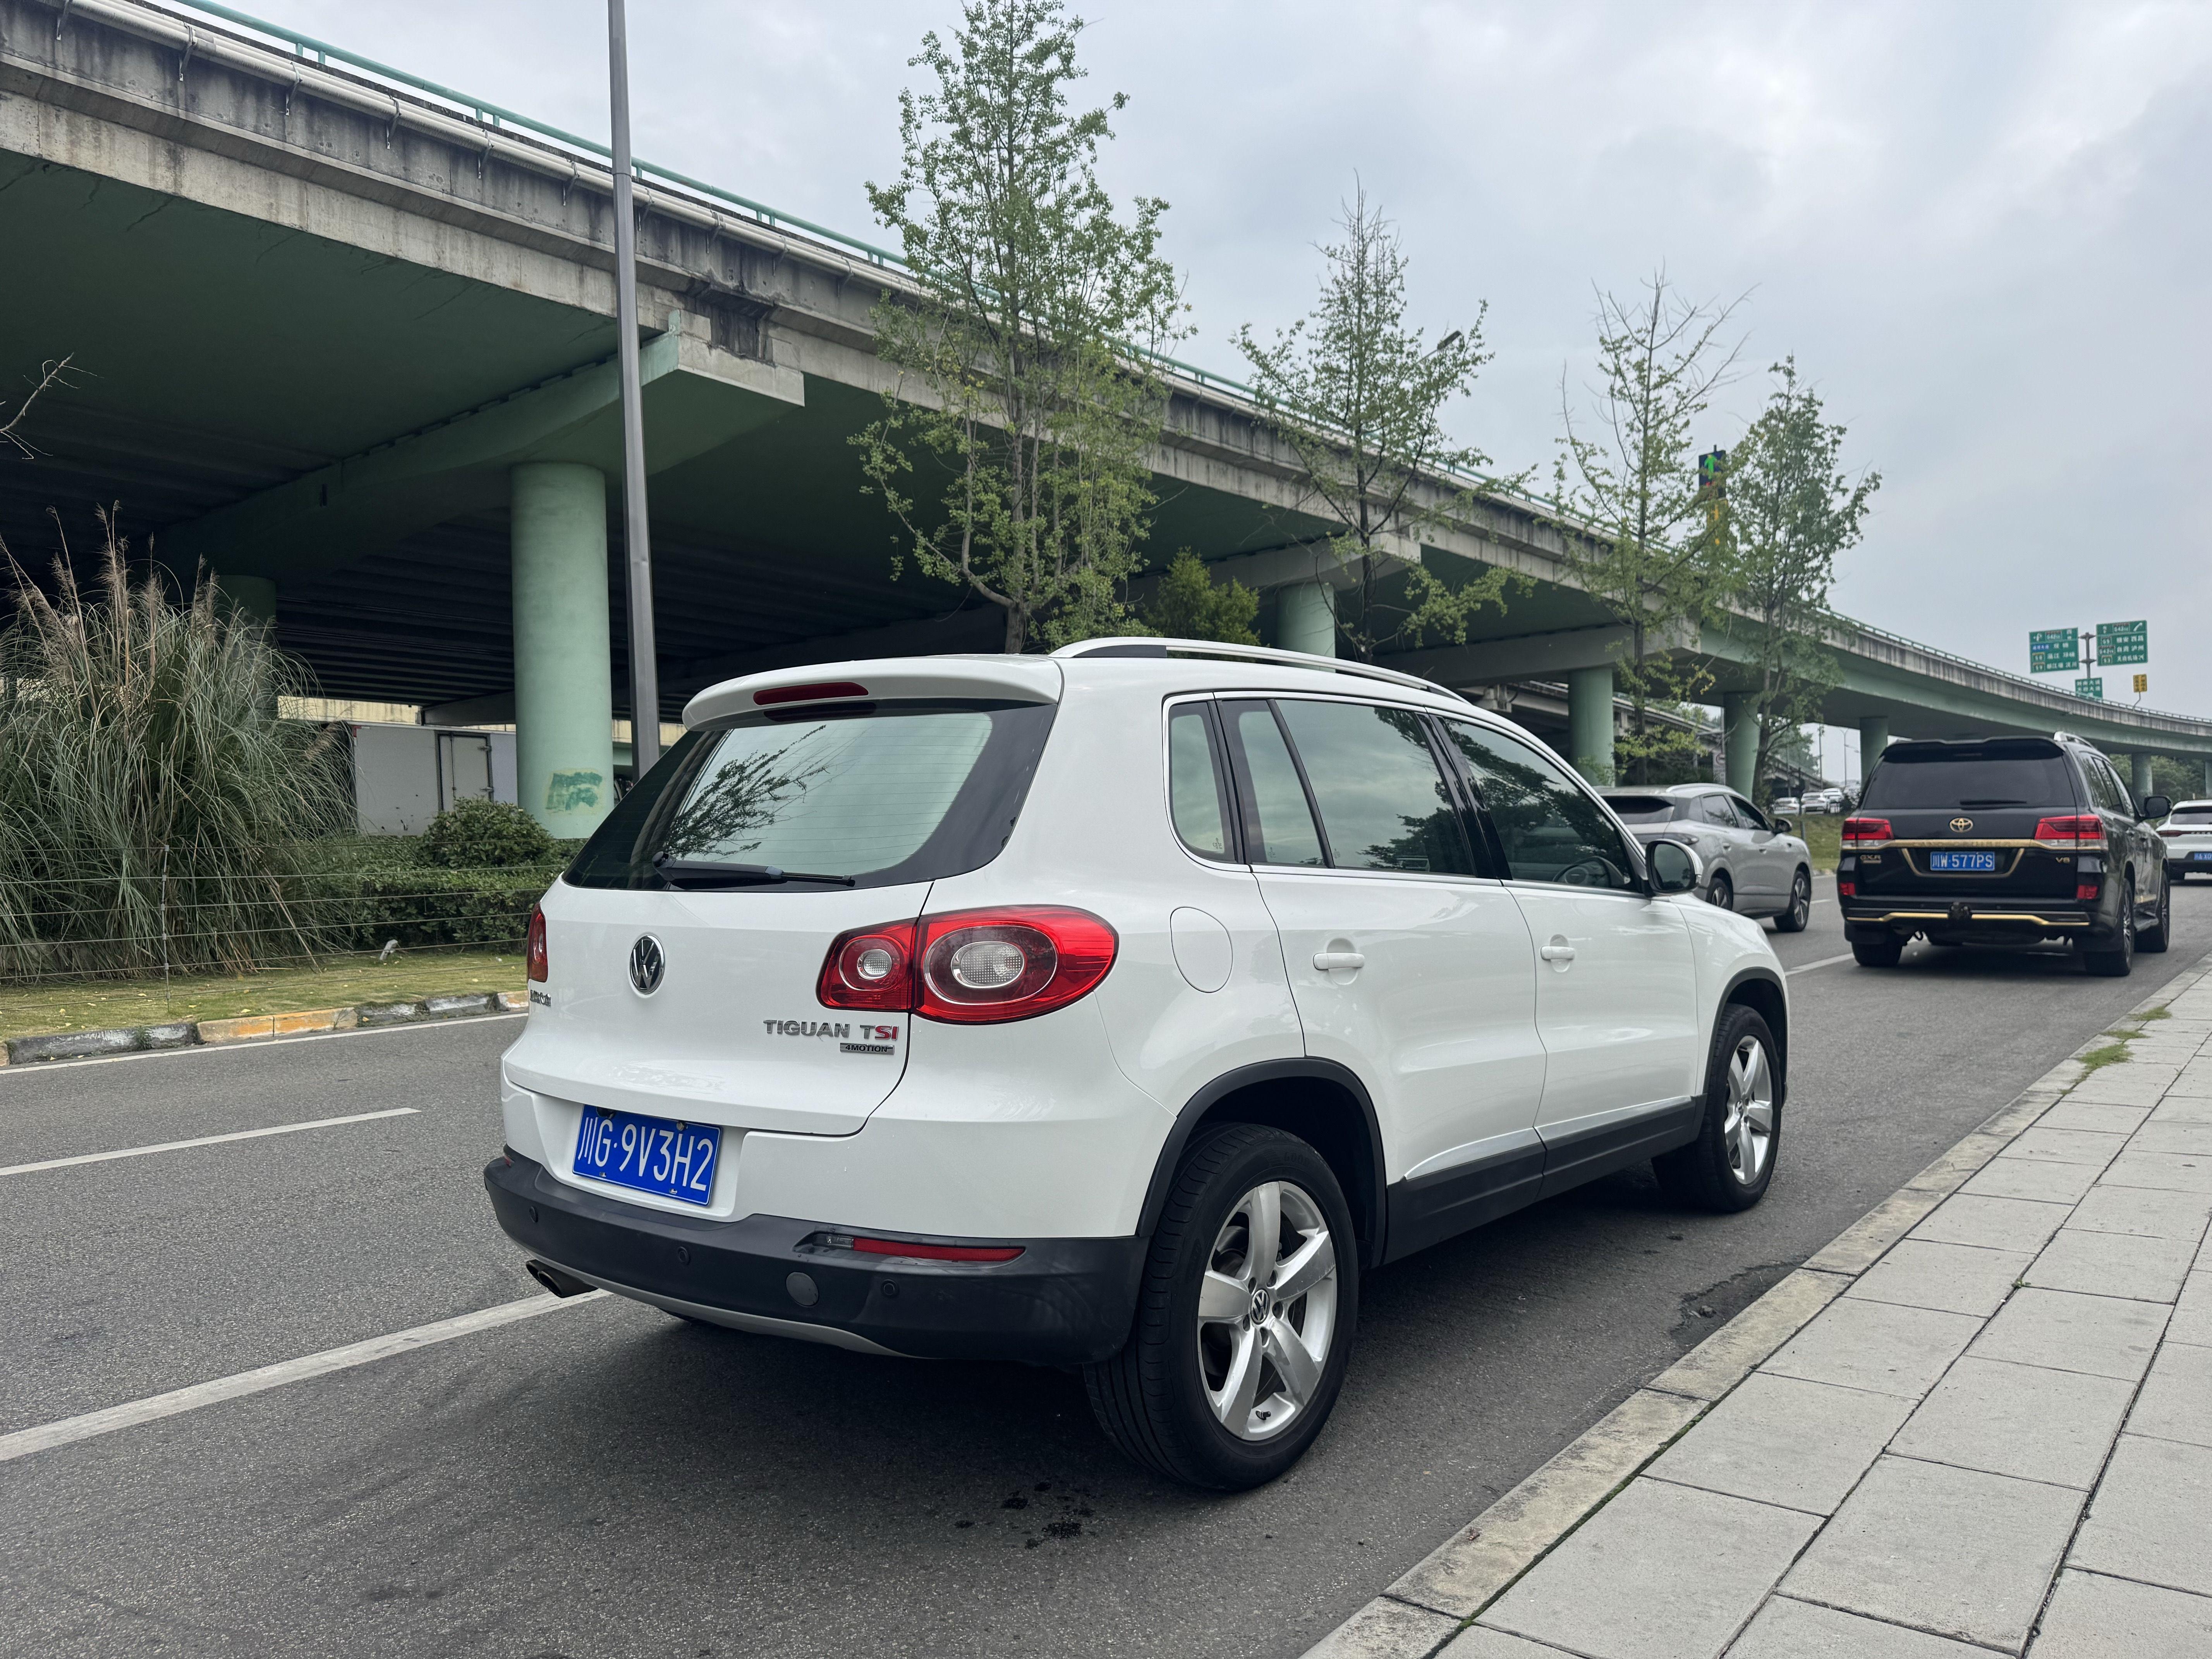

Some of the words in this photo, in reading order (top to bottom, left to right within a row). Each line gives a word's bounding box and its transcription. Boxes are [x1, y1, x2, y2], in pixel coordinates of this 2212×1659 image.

[763, 1020, 850, 1038] TIGUAN
[860, 1025, 899, 1041] TSI
[845, 1044, 888, 1053] 4MOTION
